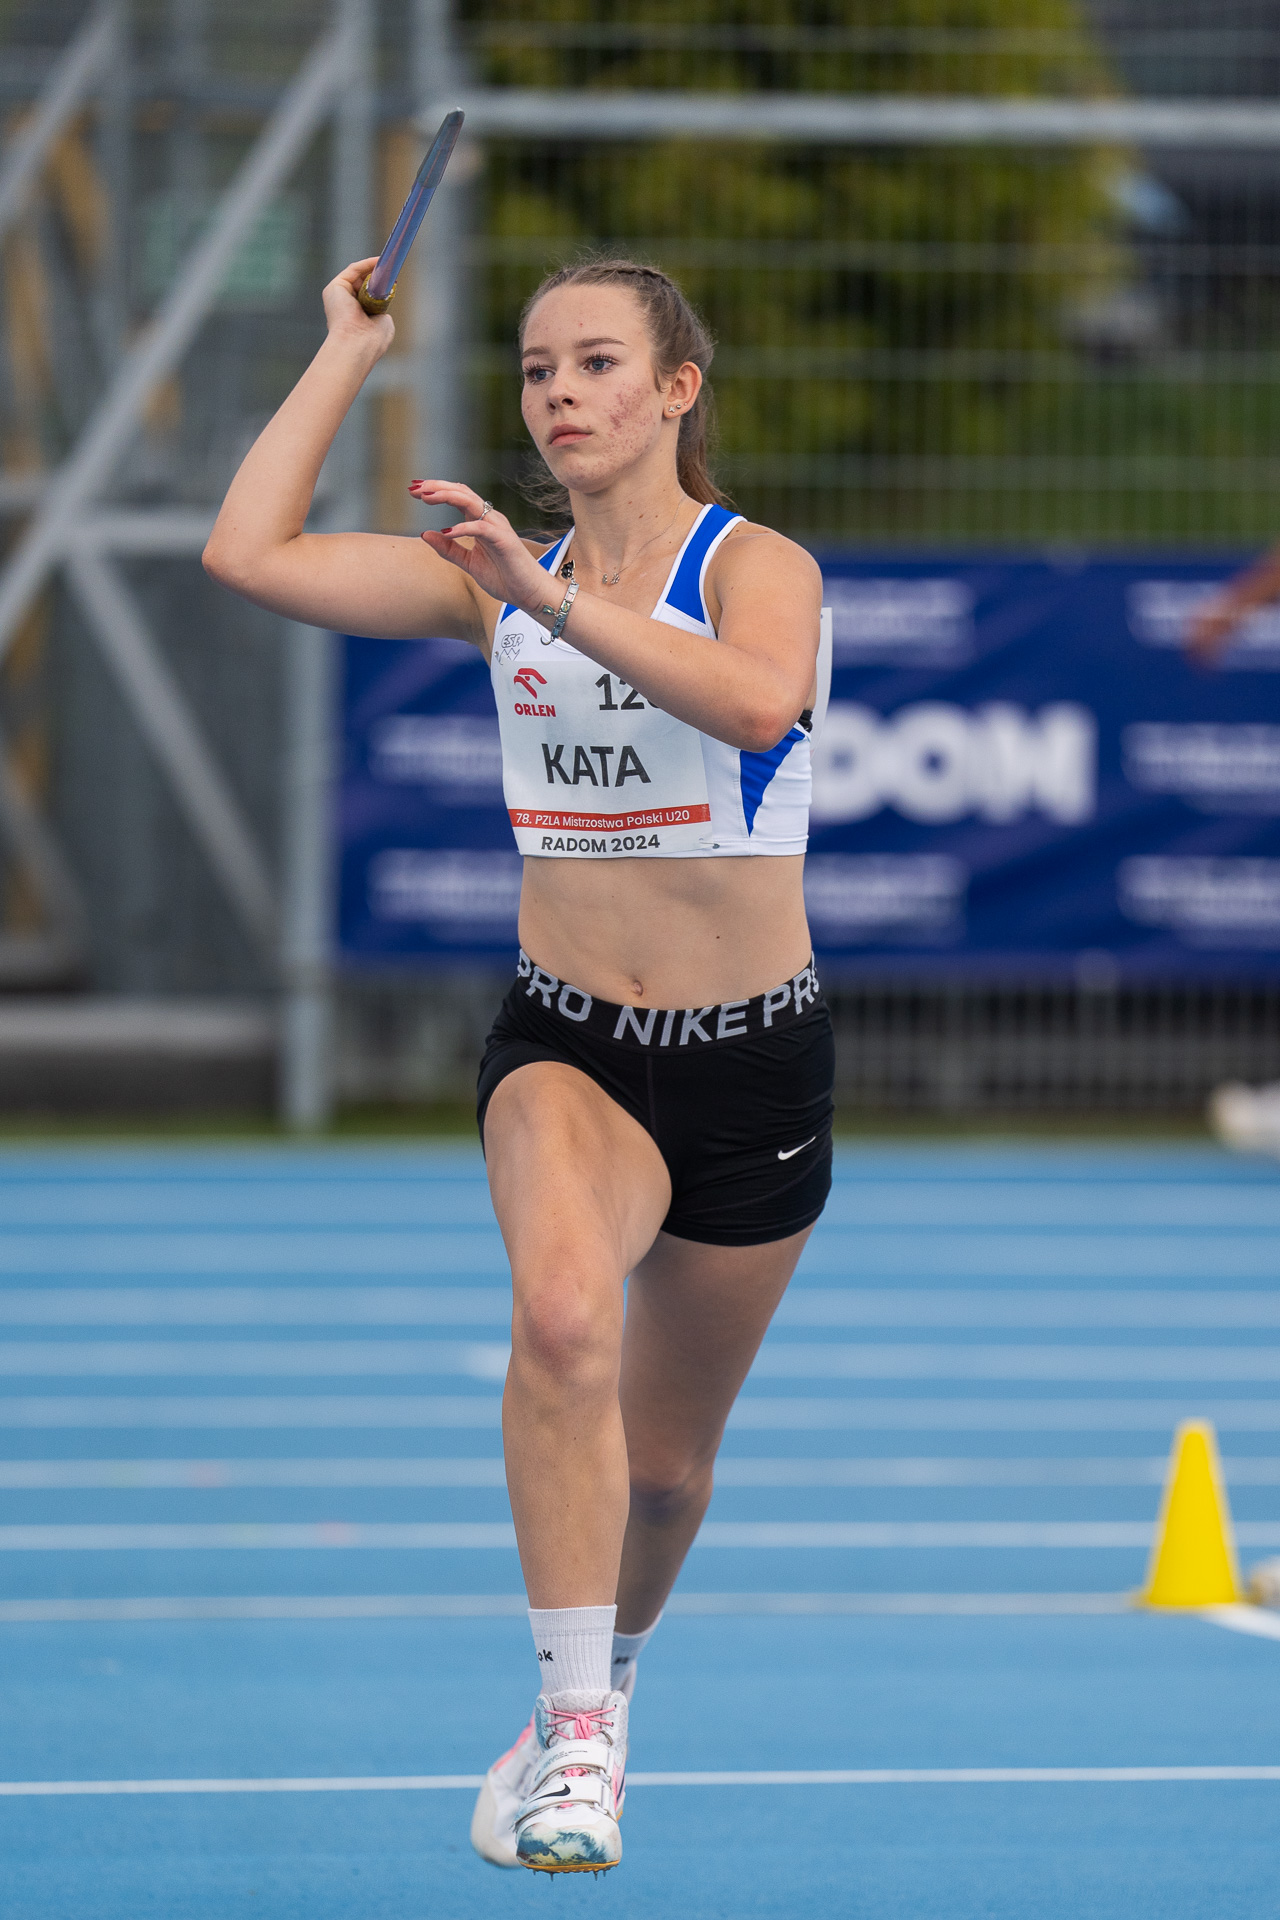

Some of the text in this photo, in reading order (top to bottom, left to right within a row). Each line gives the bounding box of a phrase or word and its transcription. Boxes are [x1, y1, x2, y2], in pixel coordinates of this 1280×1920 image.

[595, 673, 660, 710] 12
[514, 703, 556, 717] ORLEN
[541, 743, 651, 787] KATA
[516, 809, 690, 829] 78. PZLA Mistrzostwa Polski U20
[541, 834, 660, 853] RADOM 2024
[613, 998, 750, 1047] NIKE
